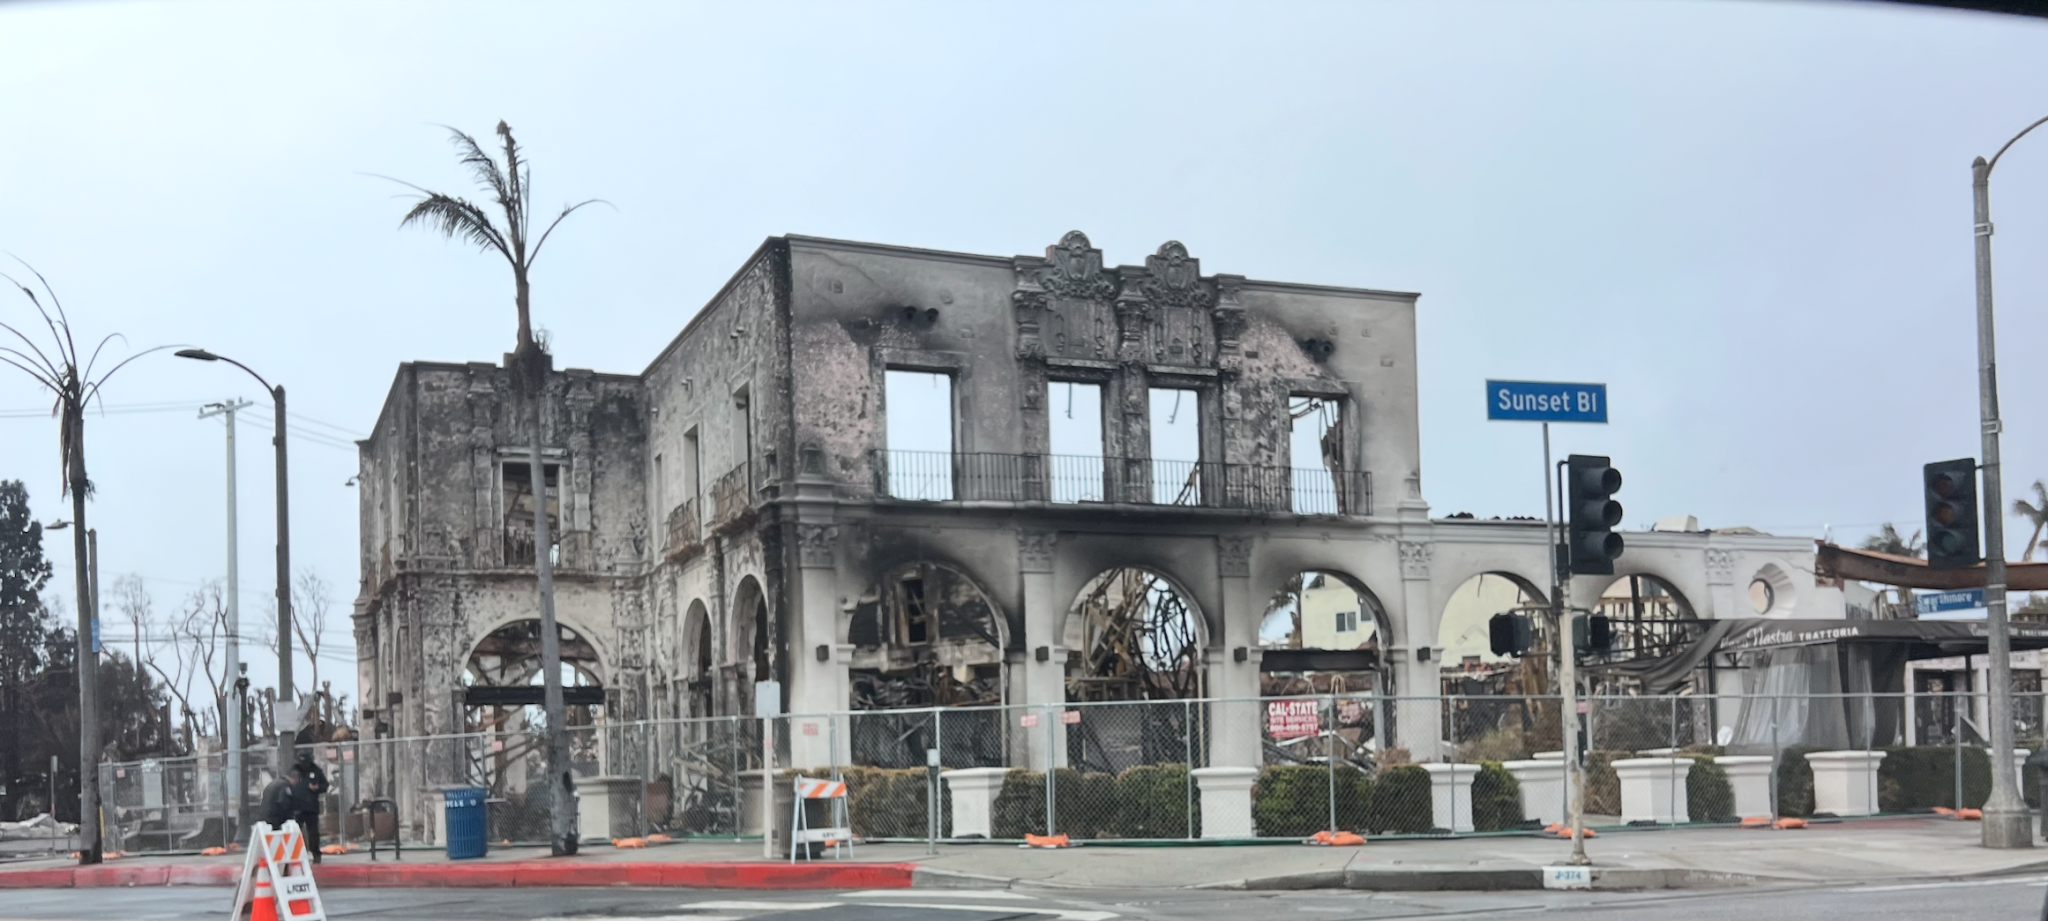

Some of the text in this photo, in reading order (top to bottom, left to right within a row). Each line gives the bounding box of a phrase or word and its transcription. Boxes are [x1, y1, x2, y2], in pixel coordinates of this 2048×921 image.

[1498, 388, 1597, 413] Sunset Bl
[1799, 626, 1859, 642] TRATTORIA
[1268, 701, 1318, 716] CAL-STATE
